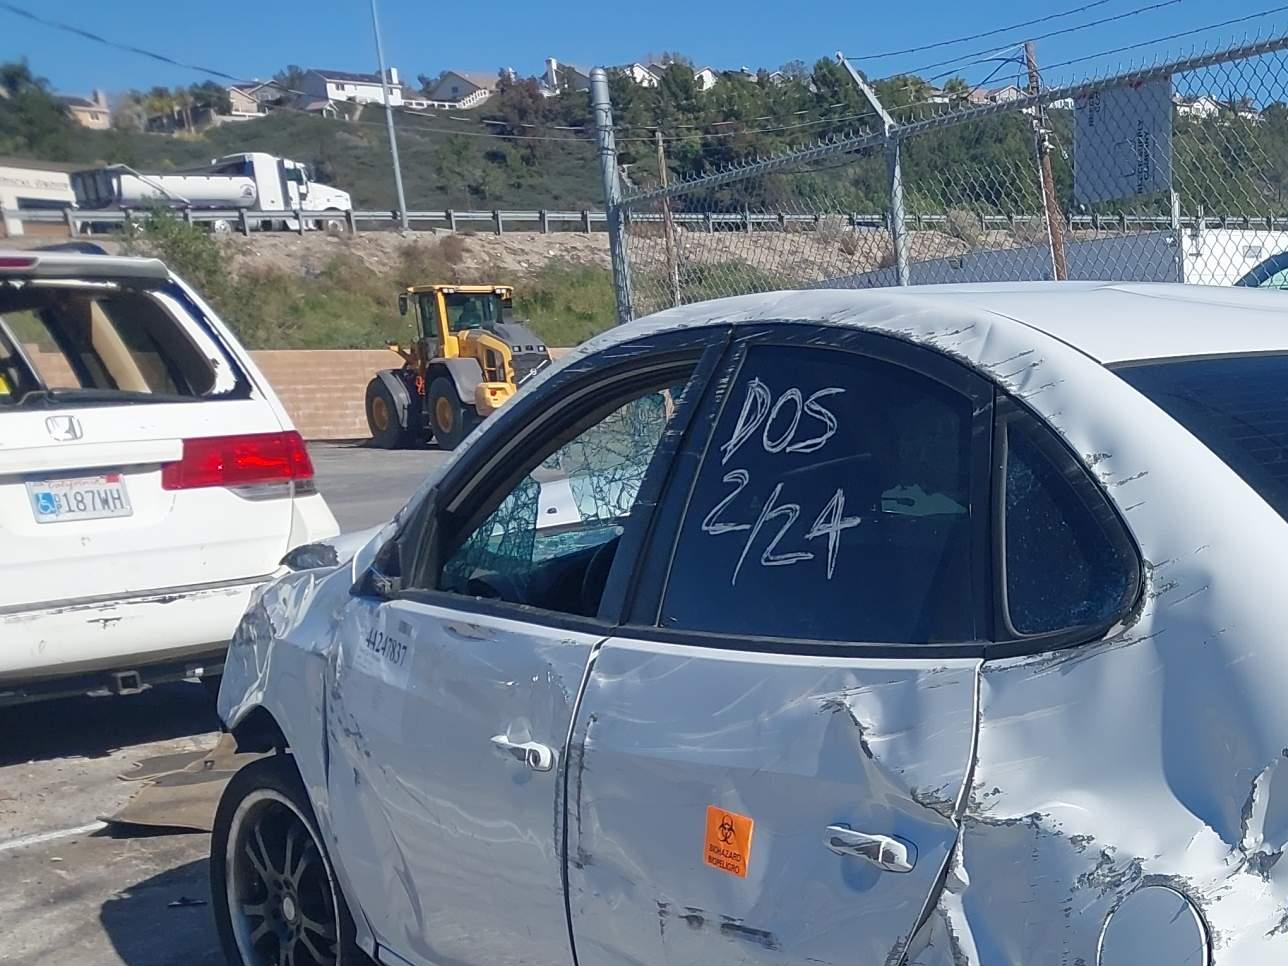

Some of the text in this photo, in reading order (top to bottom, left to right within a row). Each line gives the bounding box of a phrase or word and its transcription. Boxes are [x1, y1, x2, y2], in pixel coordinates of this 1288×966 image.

[62, 488, 125, 513] 187WH
[365, 627, 408, 667] 44247837
[709, 844, 742, 863] BIOHAZARD
